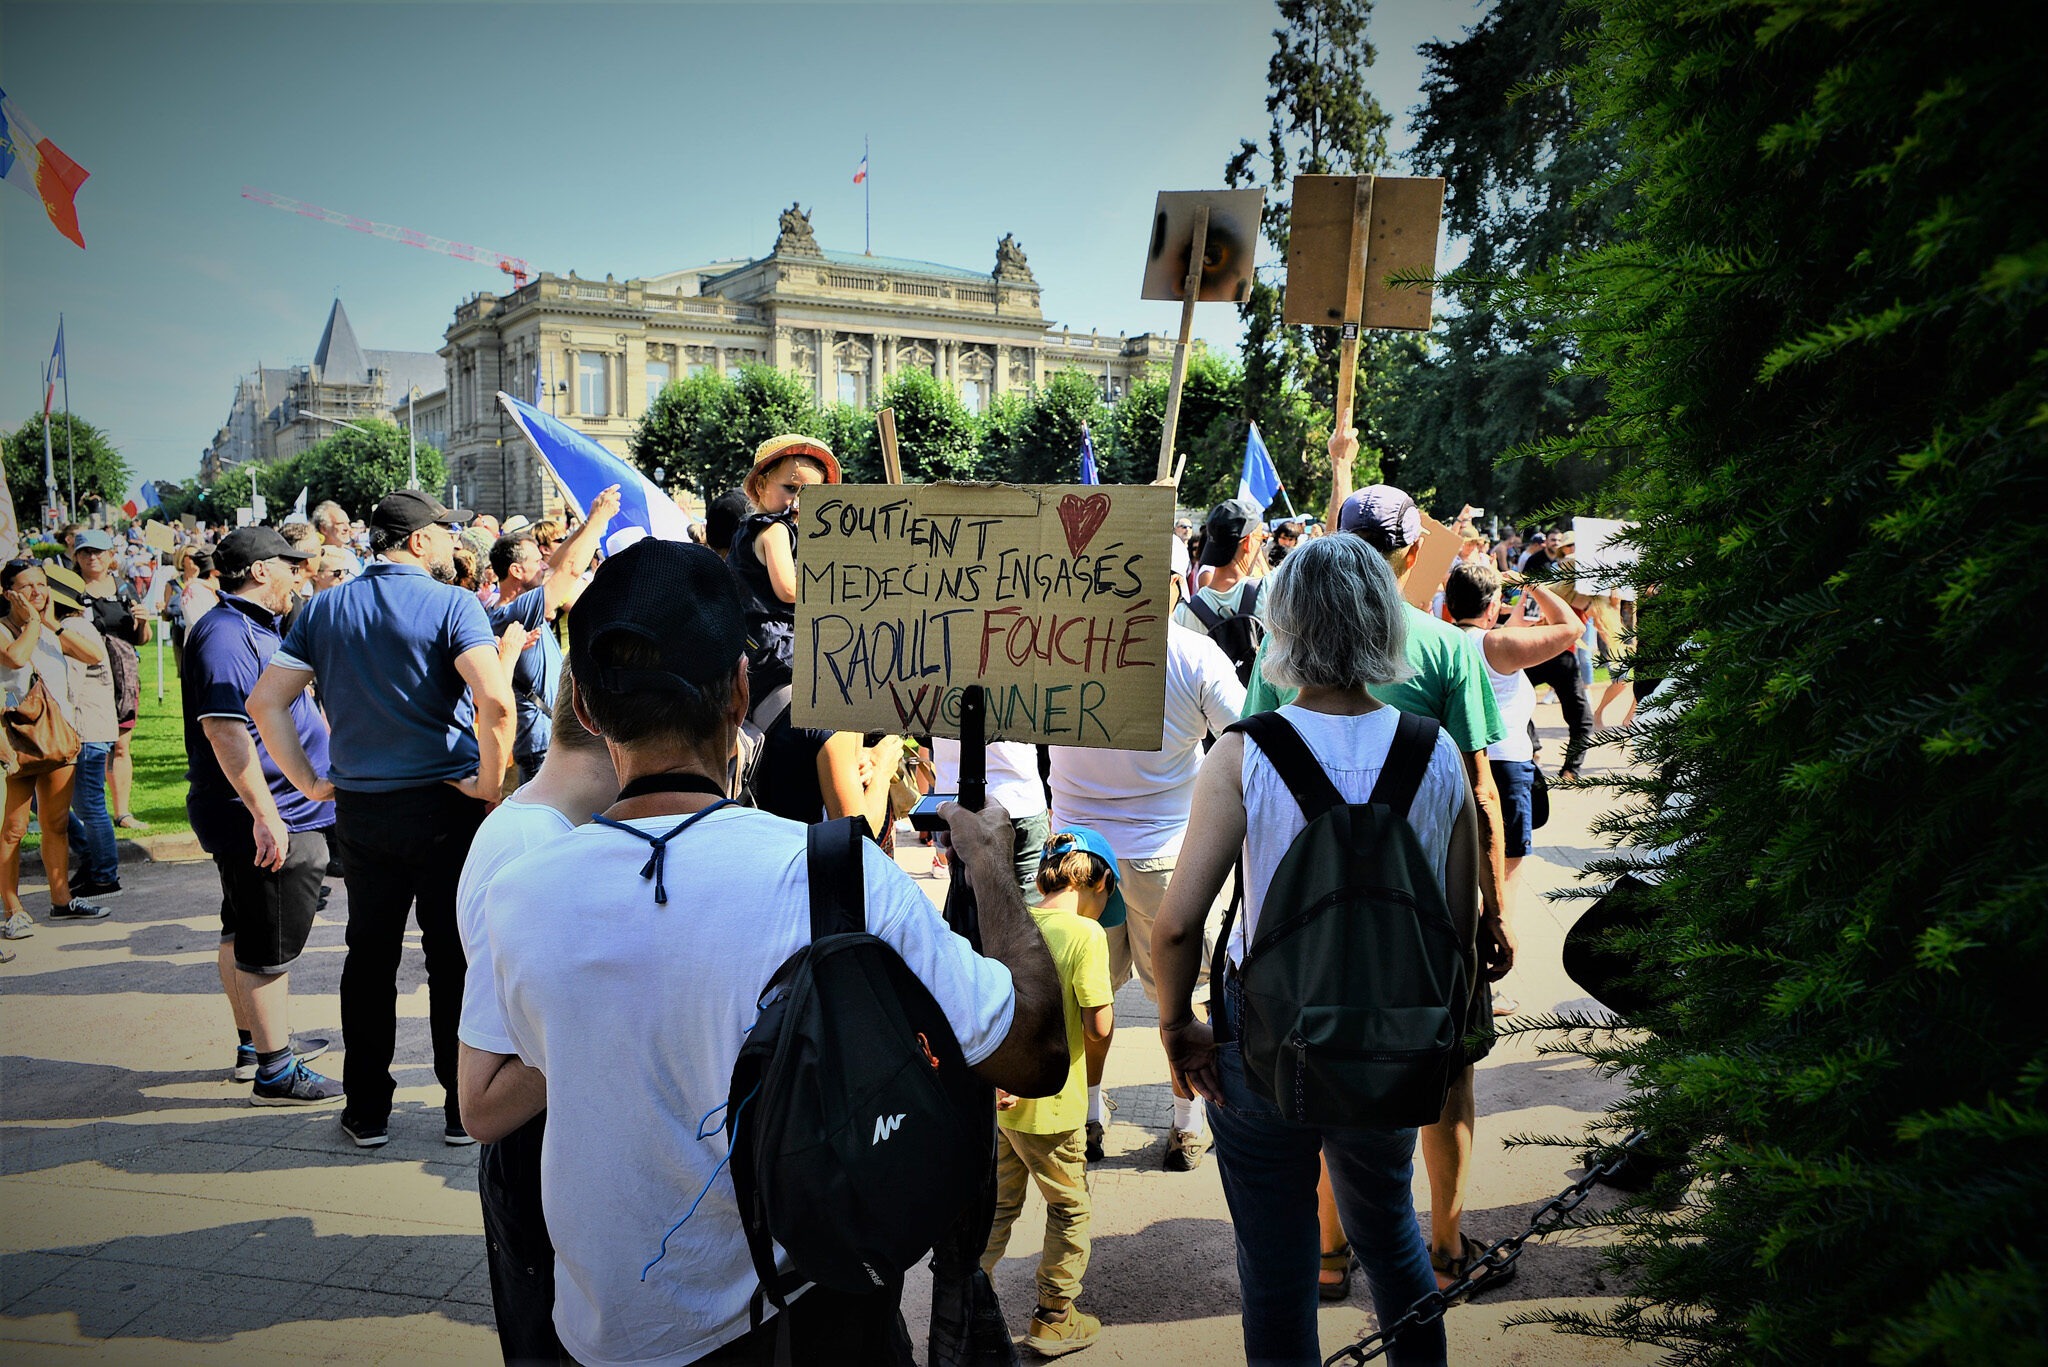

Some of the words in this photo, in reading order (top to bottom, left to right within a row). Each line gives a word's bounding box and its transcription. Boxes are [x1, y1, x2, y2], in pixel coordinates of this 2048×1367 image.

[996, 543, 1144, 602] ENGAGÉS
[811, 609, 974, 708] RAOULT
[978, 599, 1158, 679] FOUCHÉ
